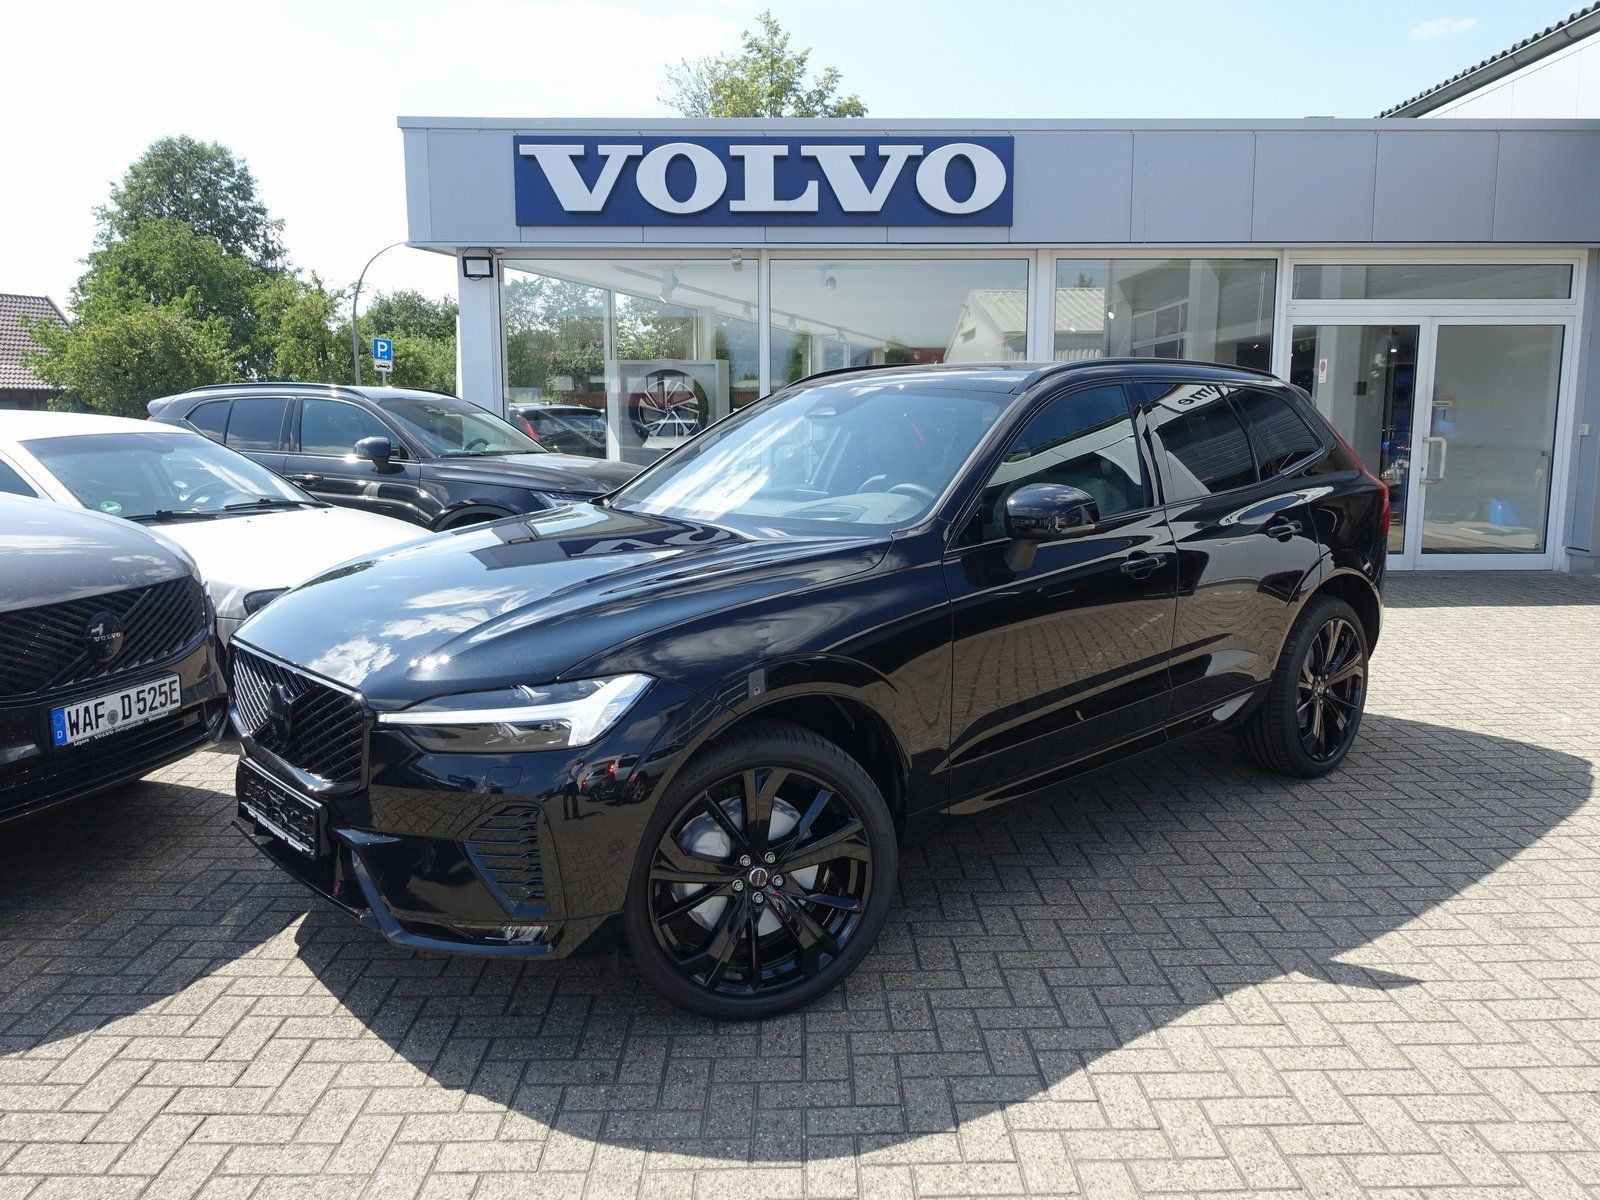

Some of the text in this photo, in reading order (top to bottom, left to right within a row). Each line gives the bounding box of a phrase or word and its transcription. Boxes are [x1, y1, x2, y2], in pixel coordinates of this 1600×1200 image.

[519, 142, 1007, 215] VOLVO
[377, 341, 388, 358] P
[67, 701, 105, 737] WAF
[120, 694, 132, 720] D
[136, 680, 179, 714] 525E
[57, 730, 63, 739] D
